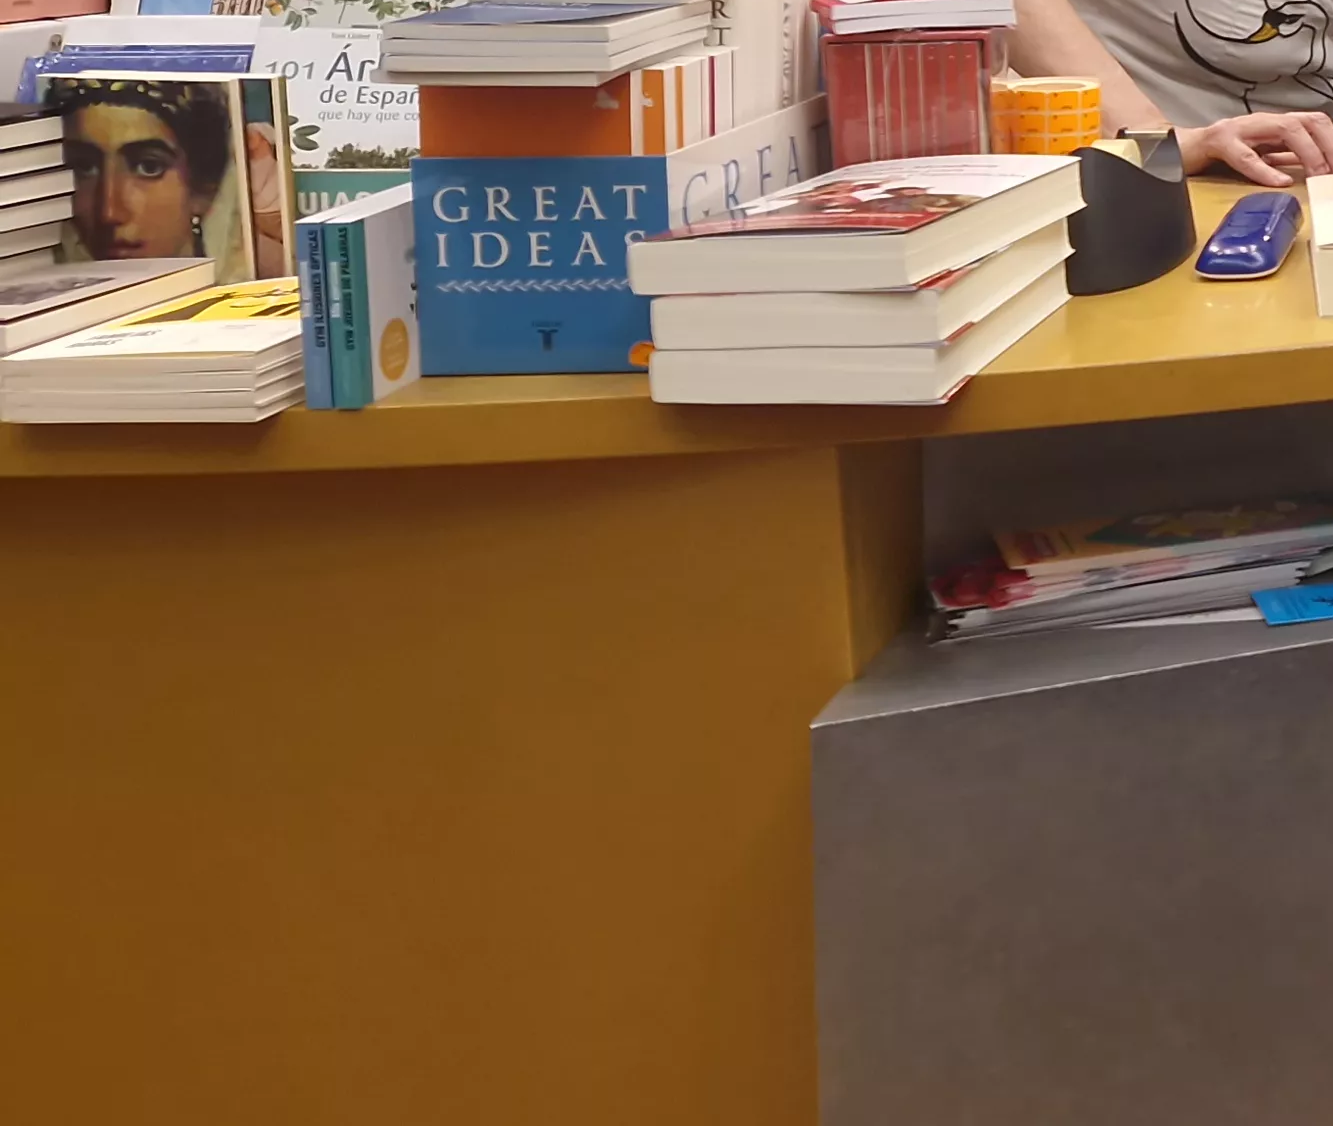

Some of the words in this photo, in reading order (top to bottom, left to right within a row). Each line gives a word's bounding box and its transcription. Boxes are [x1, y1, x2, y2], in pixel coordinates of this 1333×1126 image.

[265, 61, 314, 82] 101
[319, 84, 348, 105] de
[317, 110, 344, 124] que
[347, 109, 372, 124] hay
[376, 110, 400, 124] que
[432, 183, 648, 222] GREAT
